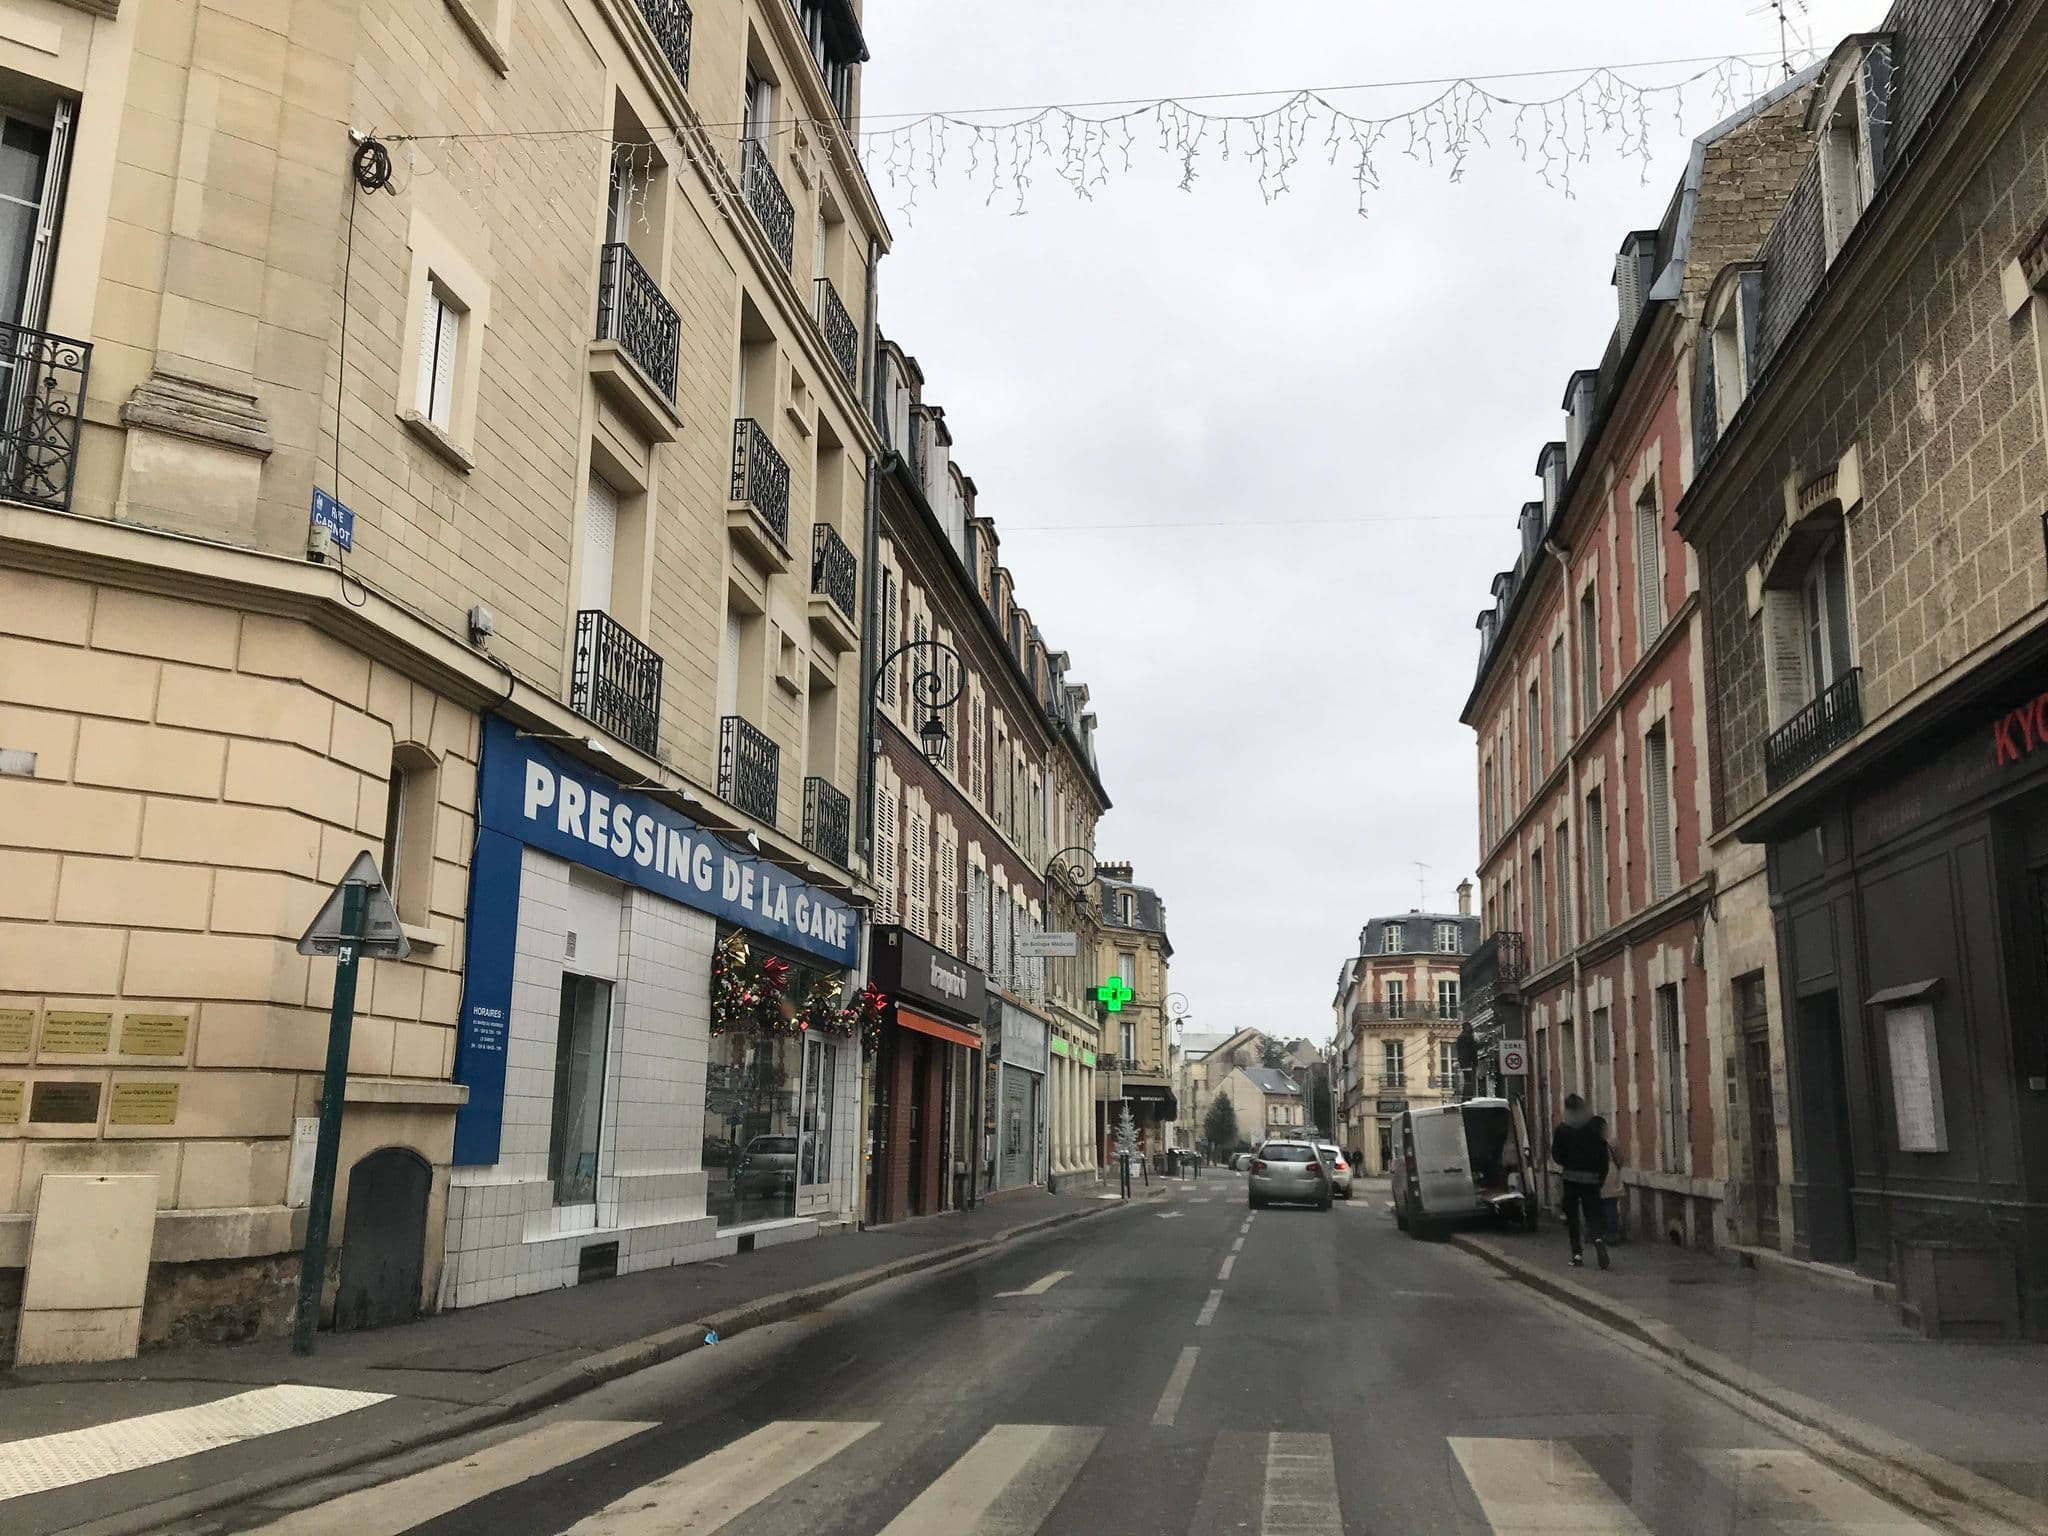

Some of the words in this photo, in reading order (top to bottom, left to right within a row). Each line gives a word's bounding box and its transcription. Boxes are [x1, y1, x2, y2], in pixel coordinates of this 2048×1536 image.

[331, 506, 344, 524] RE
[523, 758, 713, 892] PRESSING
[722, 855, 754, 911] DE
[761, 875, 789, 926] LA
[795, 894, 847, 949] GARE
[473, 1006, 502, 1018] HORAIRES
[1509, 1057, 1520, 1065] 30
